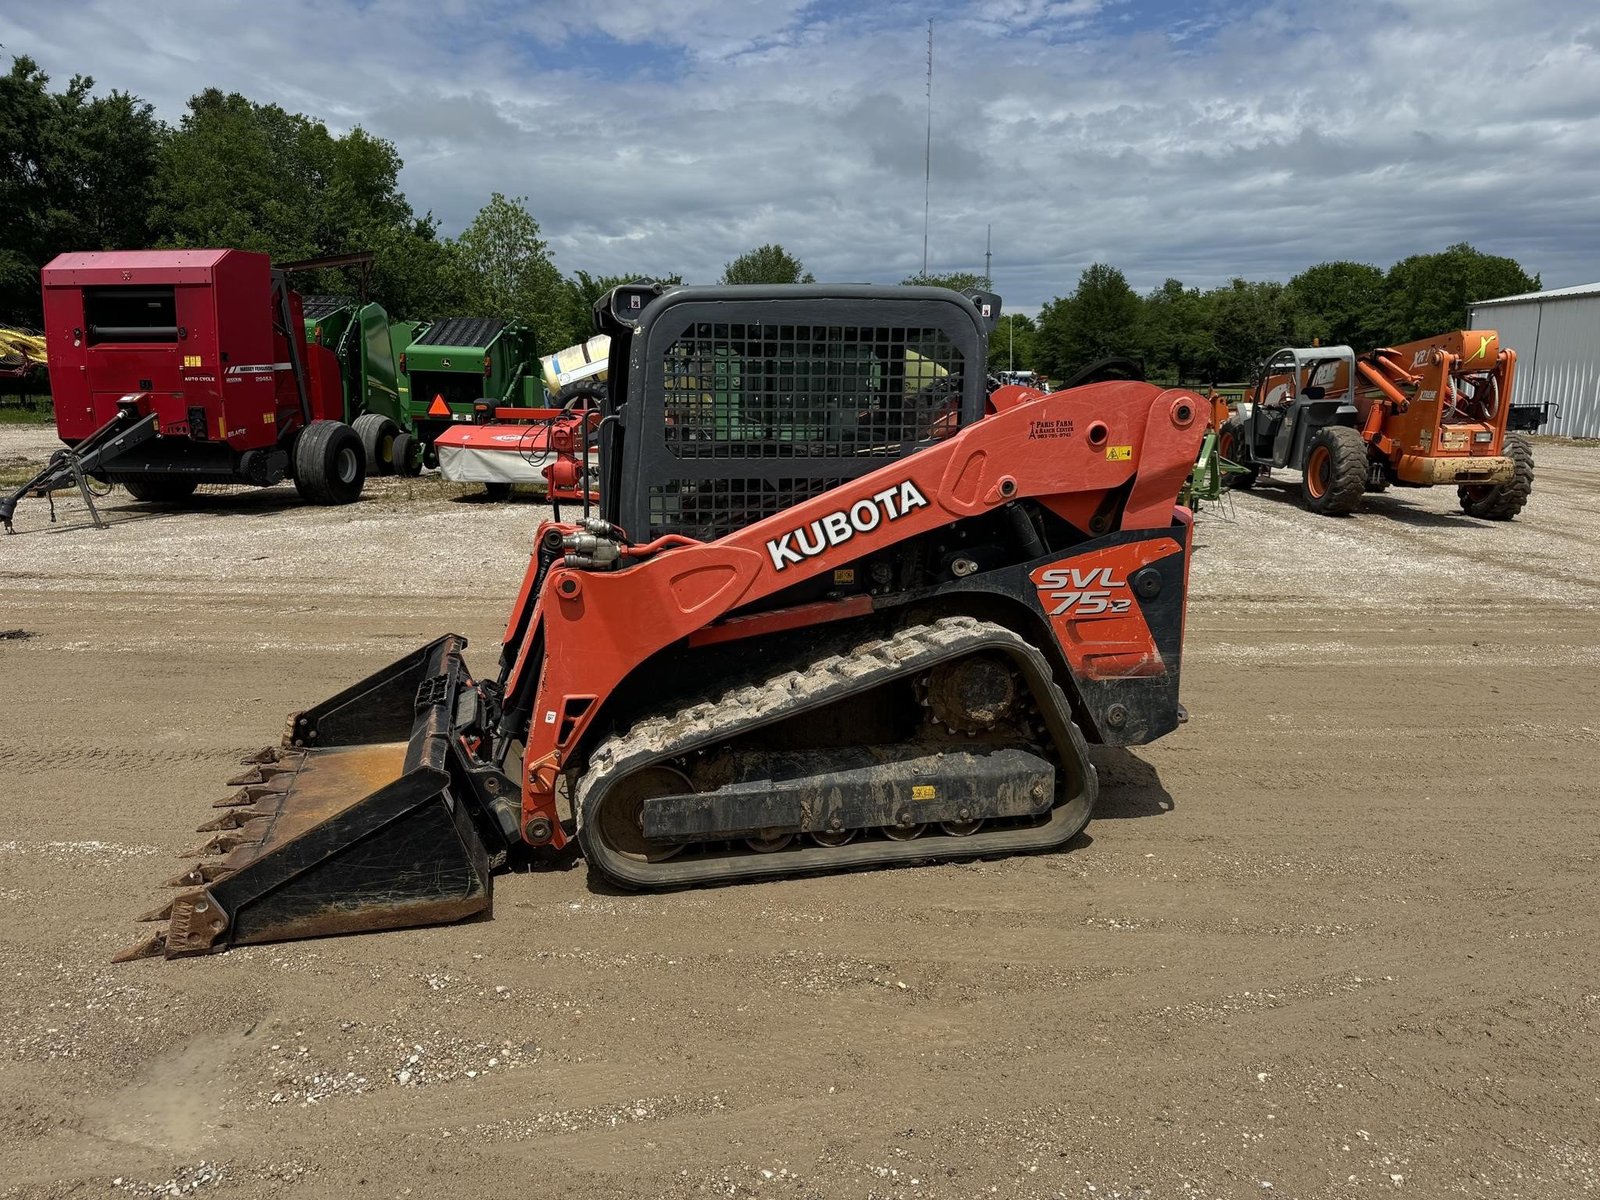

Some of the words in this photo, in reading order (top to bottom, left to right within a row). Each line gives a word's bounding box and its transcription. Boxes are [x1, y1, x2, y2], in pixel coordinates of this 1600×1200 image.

[765, 480, 928, 571] KUBOTA
[1037, 568, 1126, 589] SVL
[1048, 591, 1132, 616] 75-2
